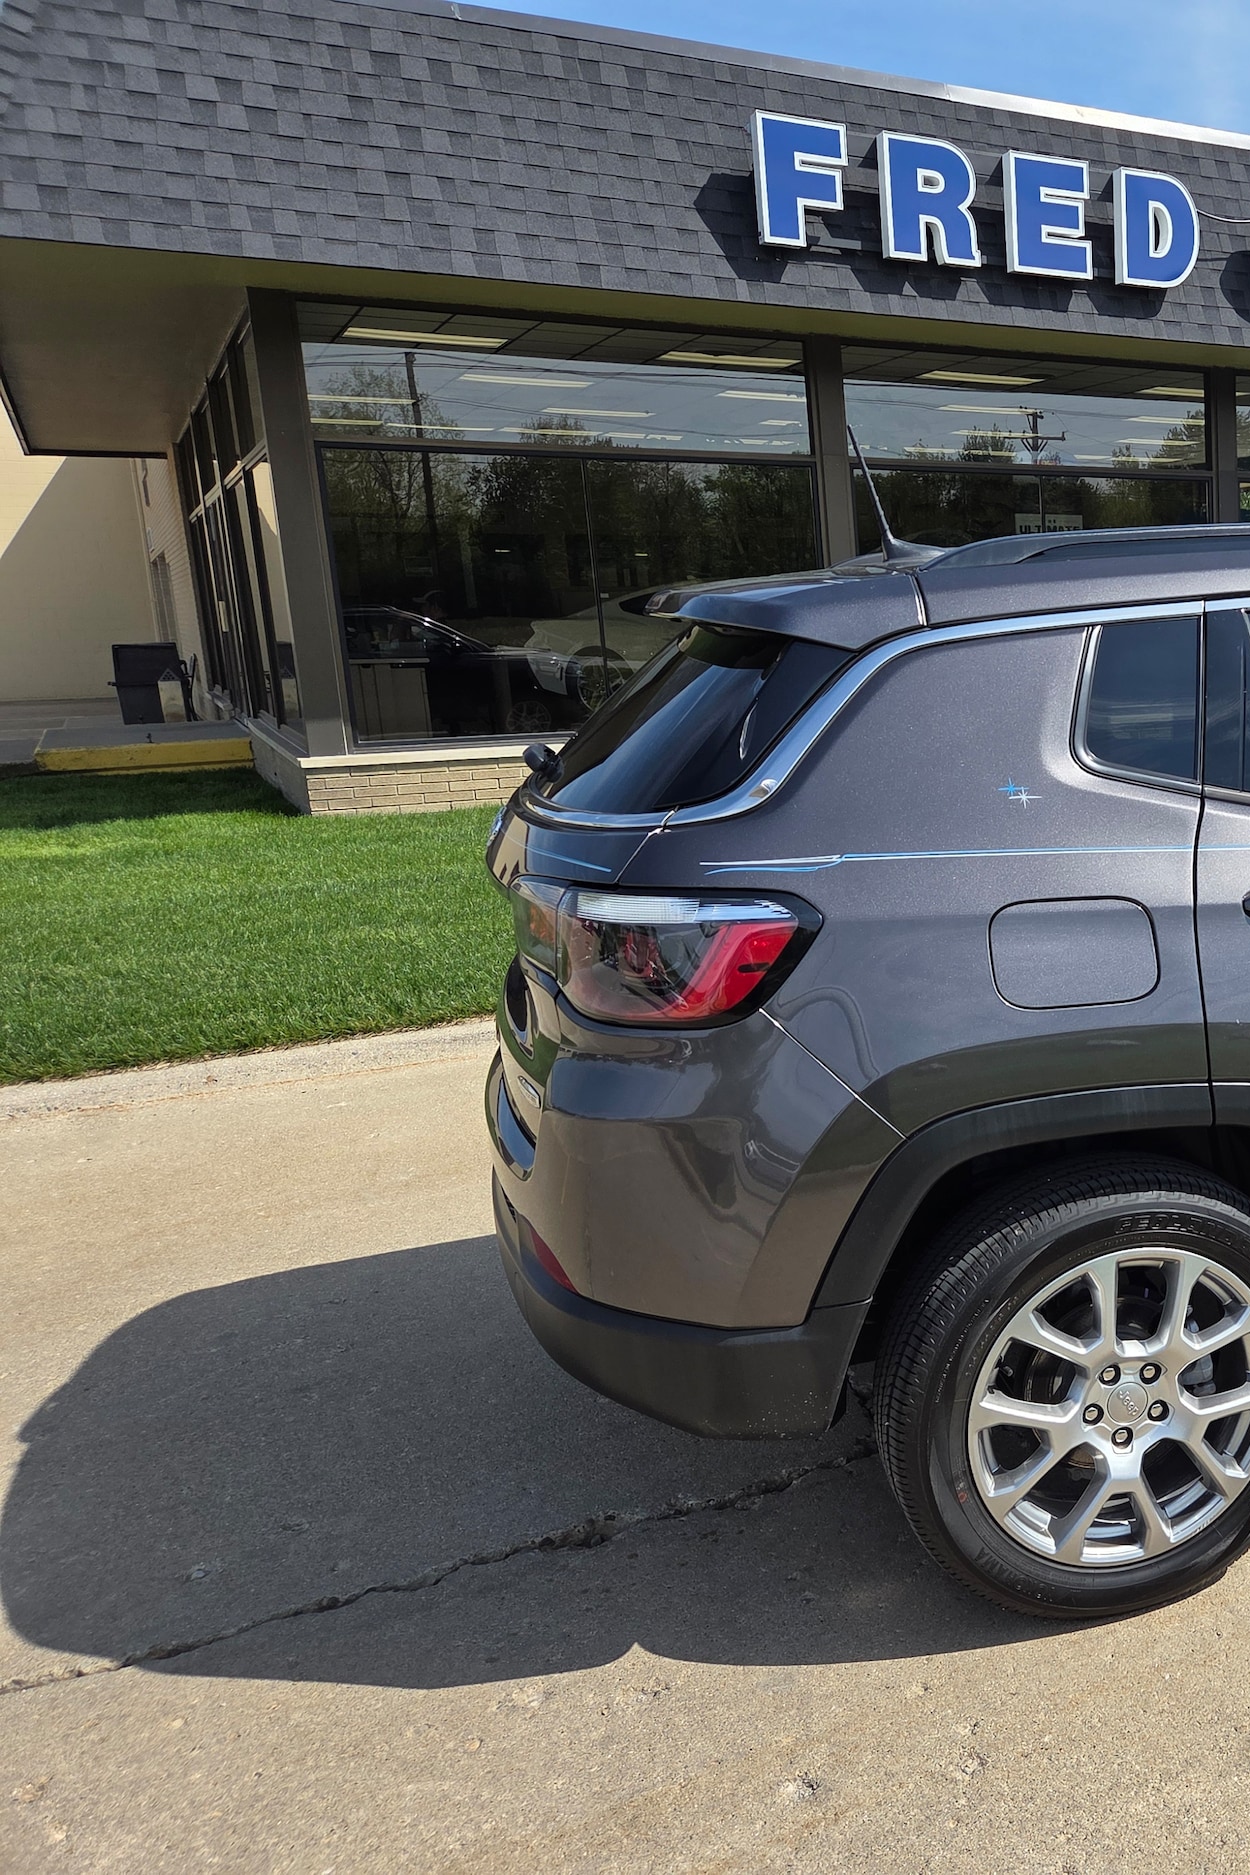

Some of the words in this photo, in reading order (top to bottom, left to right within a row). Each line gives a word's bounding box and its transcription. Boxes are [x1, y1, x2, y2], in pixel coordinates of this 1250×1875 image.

[752, 110, 1200, 288] FRED
[1019, 525, 1080, 534] ULTMA
[1118, 1390, 1139, 1415] Jeep
